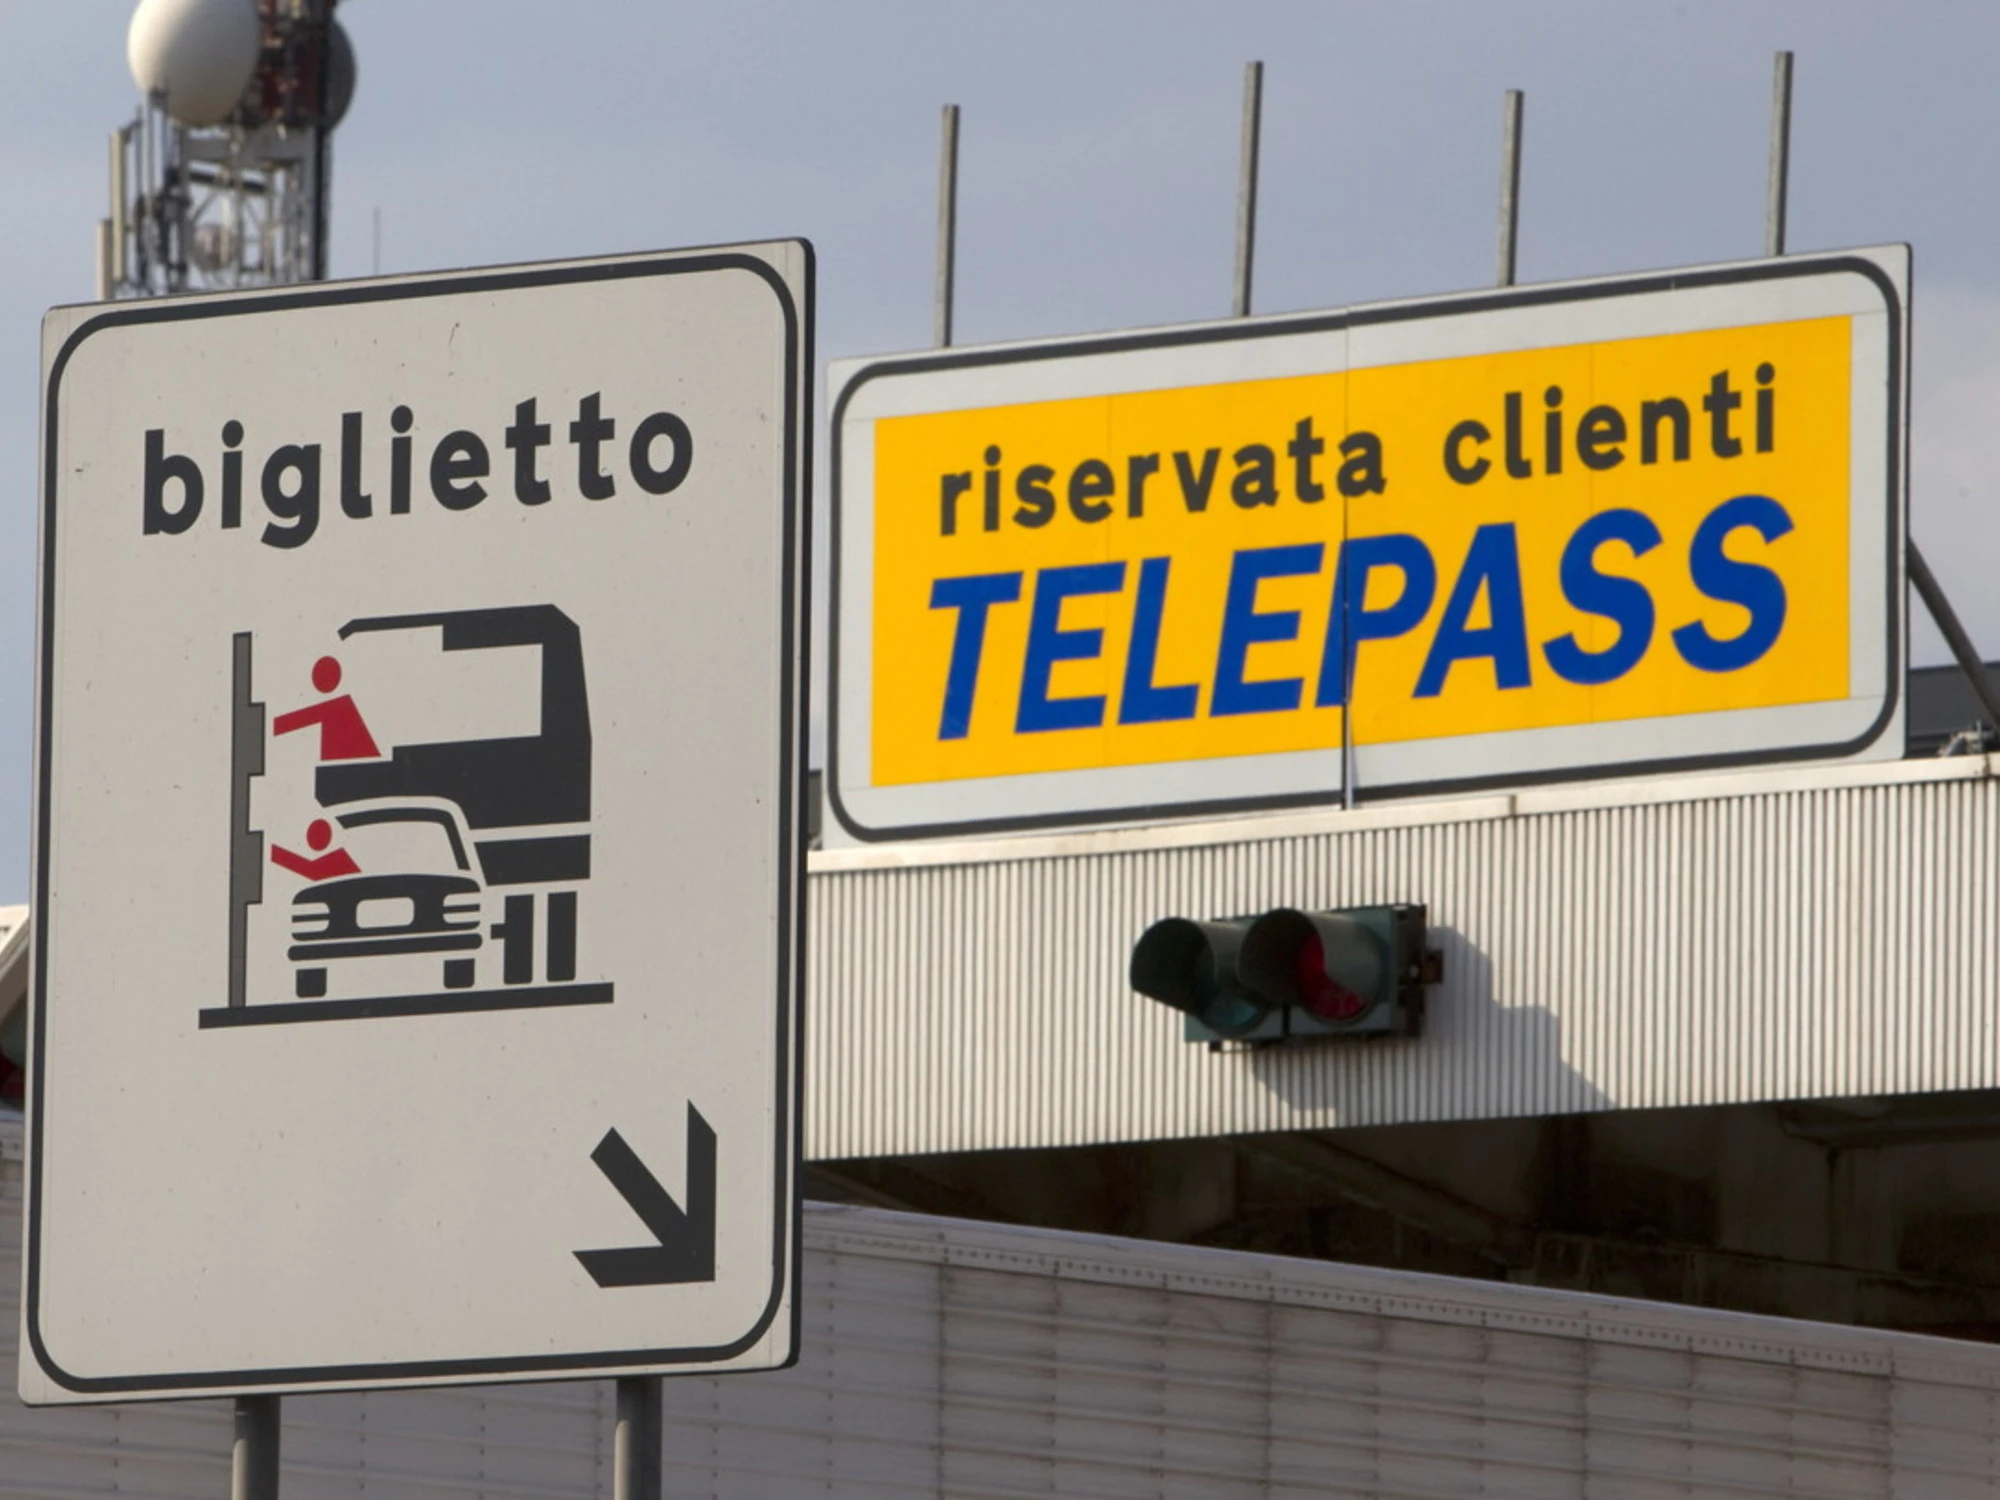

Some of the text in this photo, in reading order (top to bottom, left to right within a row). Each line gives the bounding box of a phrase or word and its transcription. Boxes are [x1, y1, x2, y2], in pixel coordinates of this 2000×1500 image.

[143, 391, 693, 549] biglietto
[940, 362, 1776, 536] riservata clienti
[928, 494, 1795, 740] TELEPASS
